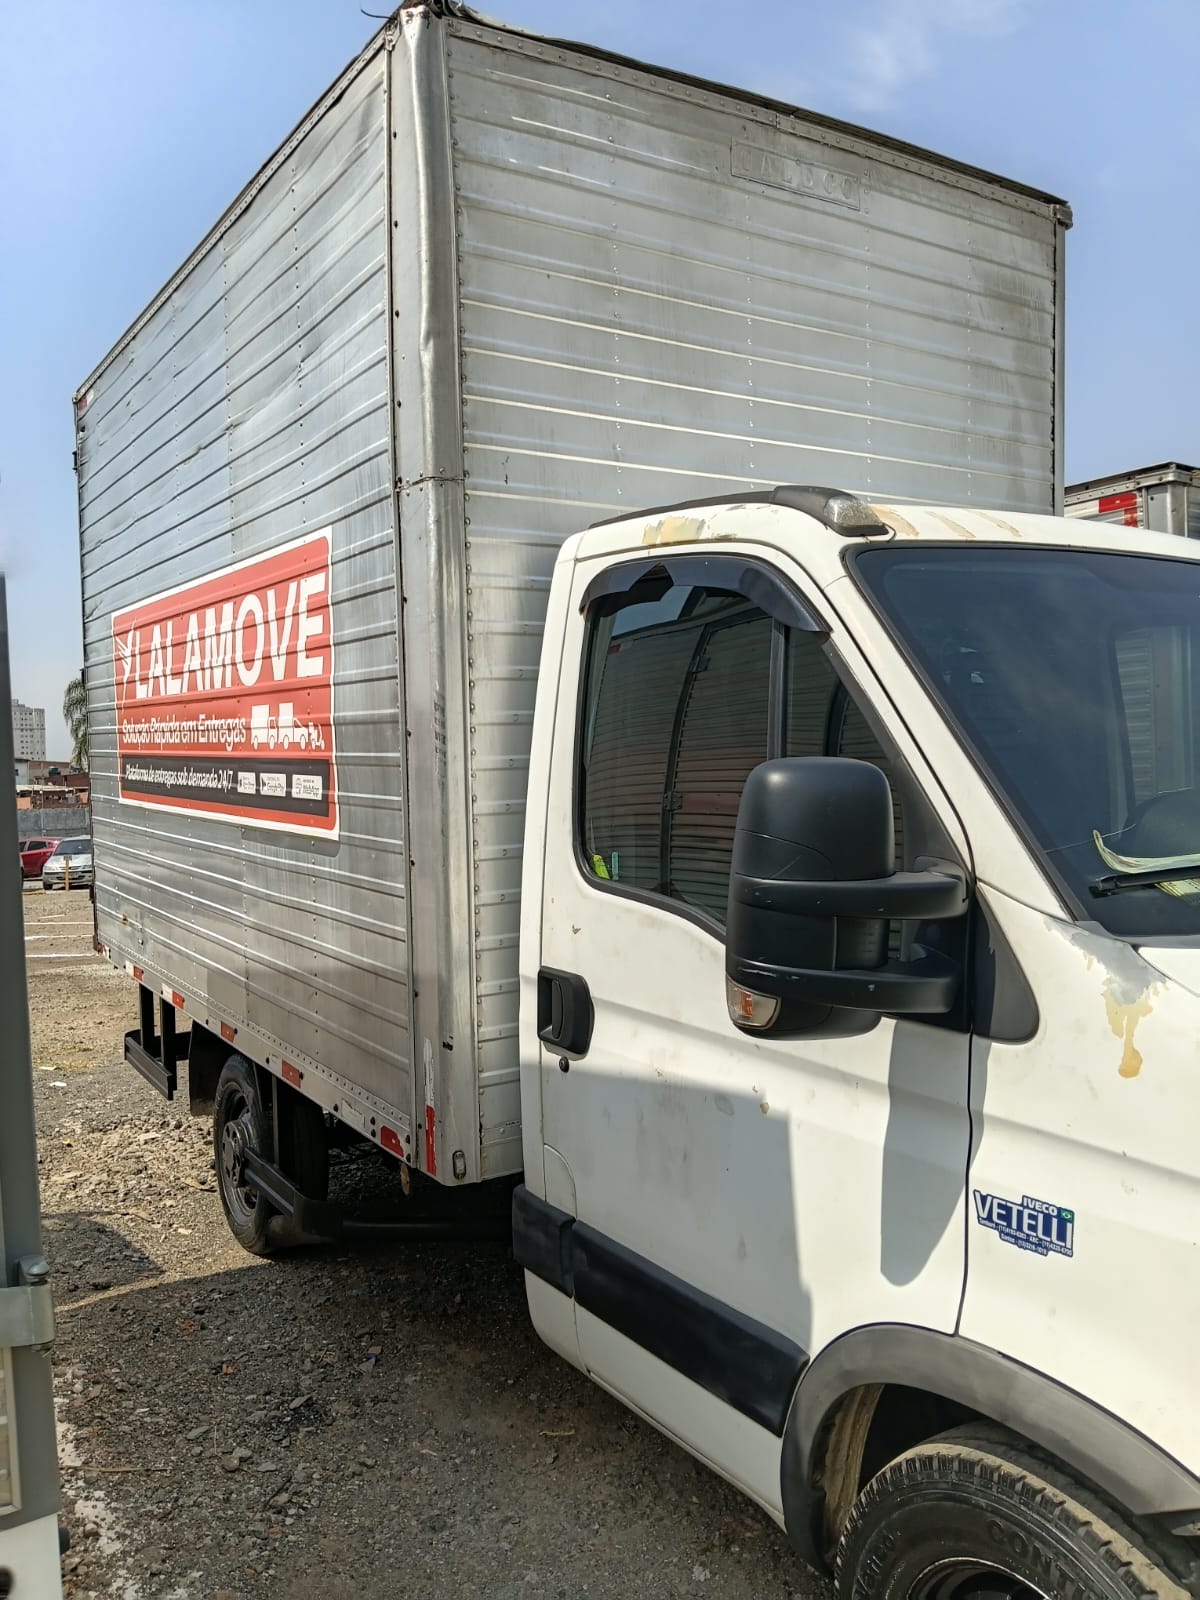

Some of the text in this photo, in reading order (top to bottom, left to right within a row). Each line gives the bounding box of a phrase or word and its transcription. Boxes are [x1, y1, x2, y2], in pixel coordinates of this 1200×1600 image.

[136, 572, 326, 699] LALAMOVE
[123, 714, 246, 752] Solução Rápida em Entregas
[155, 768, 177, 789] entregas
[177, 767, 188, 785] sob
[188, 767, 218, 788] demanda
[218, 768, 234, 792] 24/7
[974, 1191, 1073, 1249] VETELLI
[1023, 1197, 1057, 1216] IVECO
